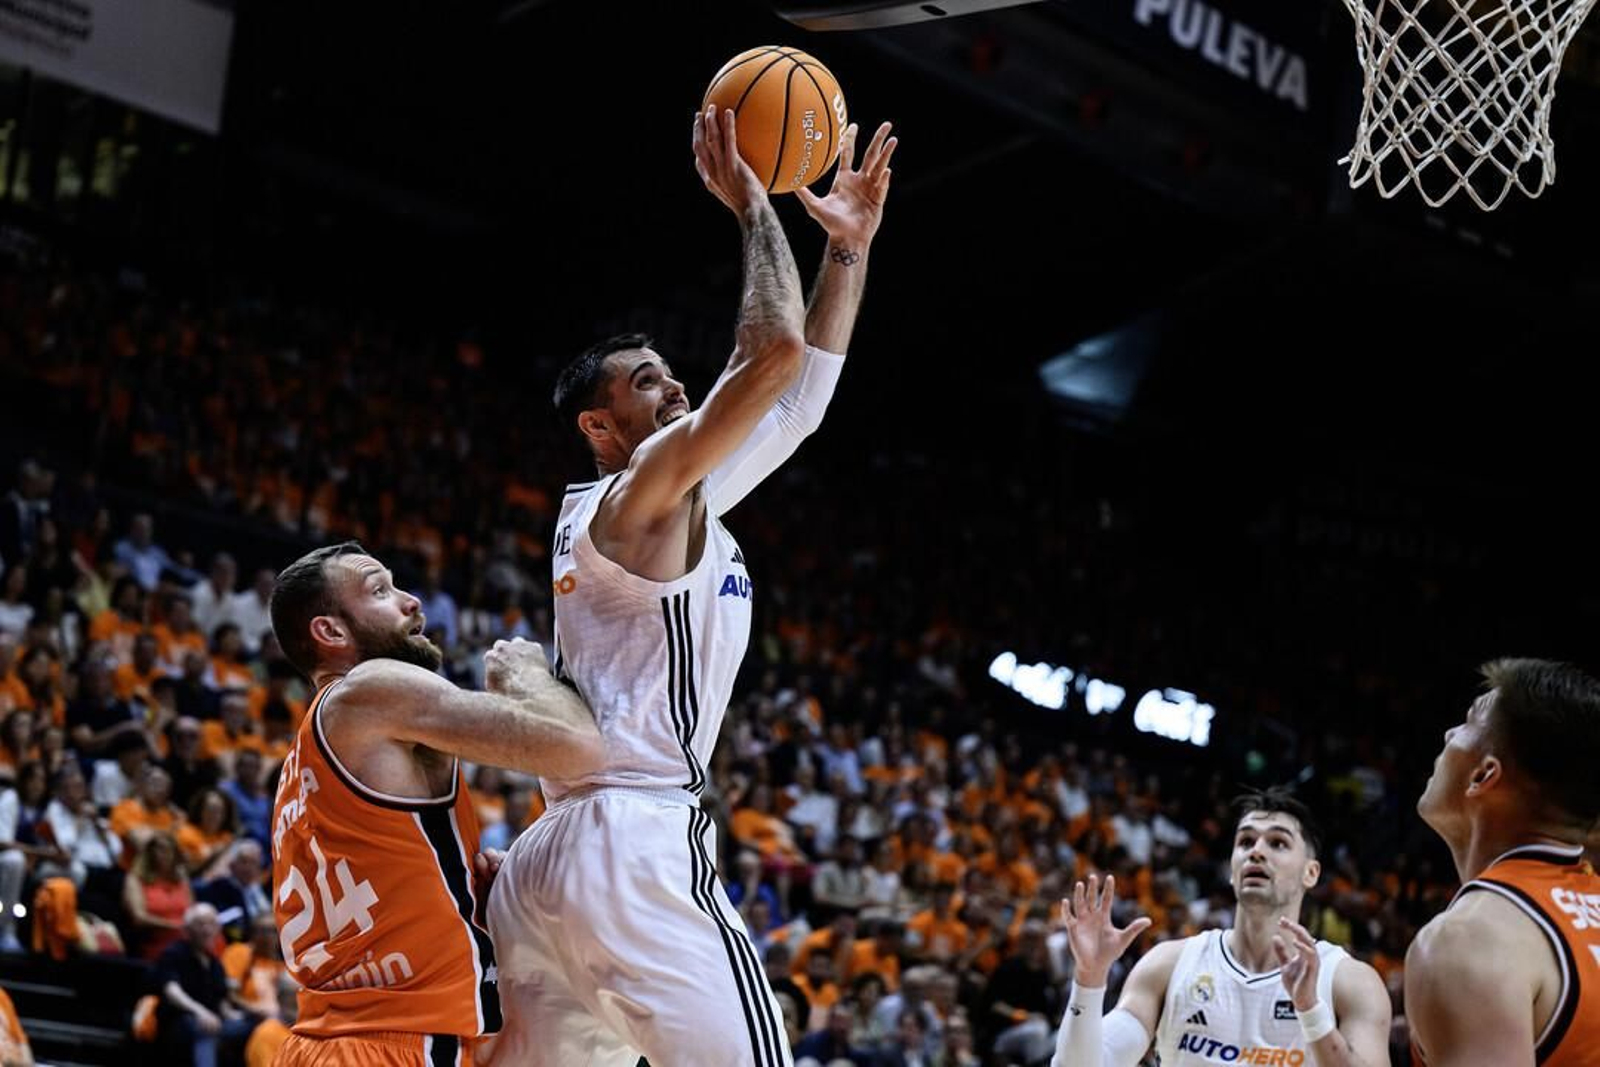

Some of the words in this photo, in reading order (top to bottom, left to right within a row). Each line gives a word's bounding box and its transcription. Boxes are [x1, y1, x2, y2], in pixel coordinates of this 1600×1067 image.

[1134, 0, 1308, 111] PULEVA
[802, 110, 816, 139] liga
[278, 835, 380, 973] 24
[1177, 1032, 1305, 1067] AUTOHERO
